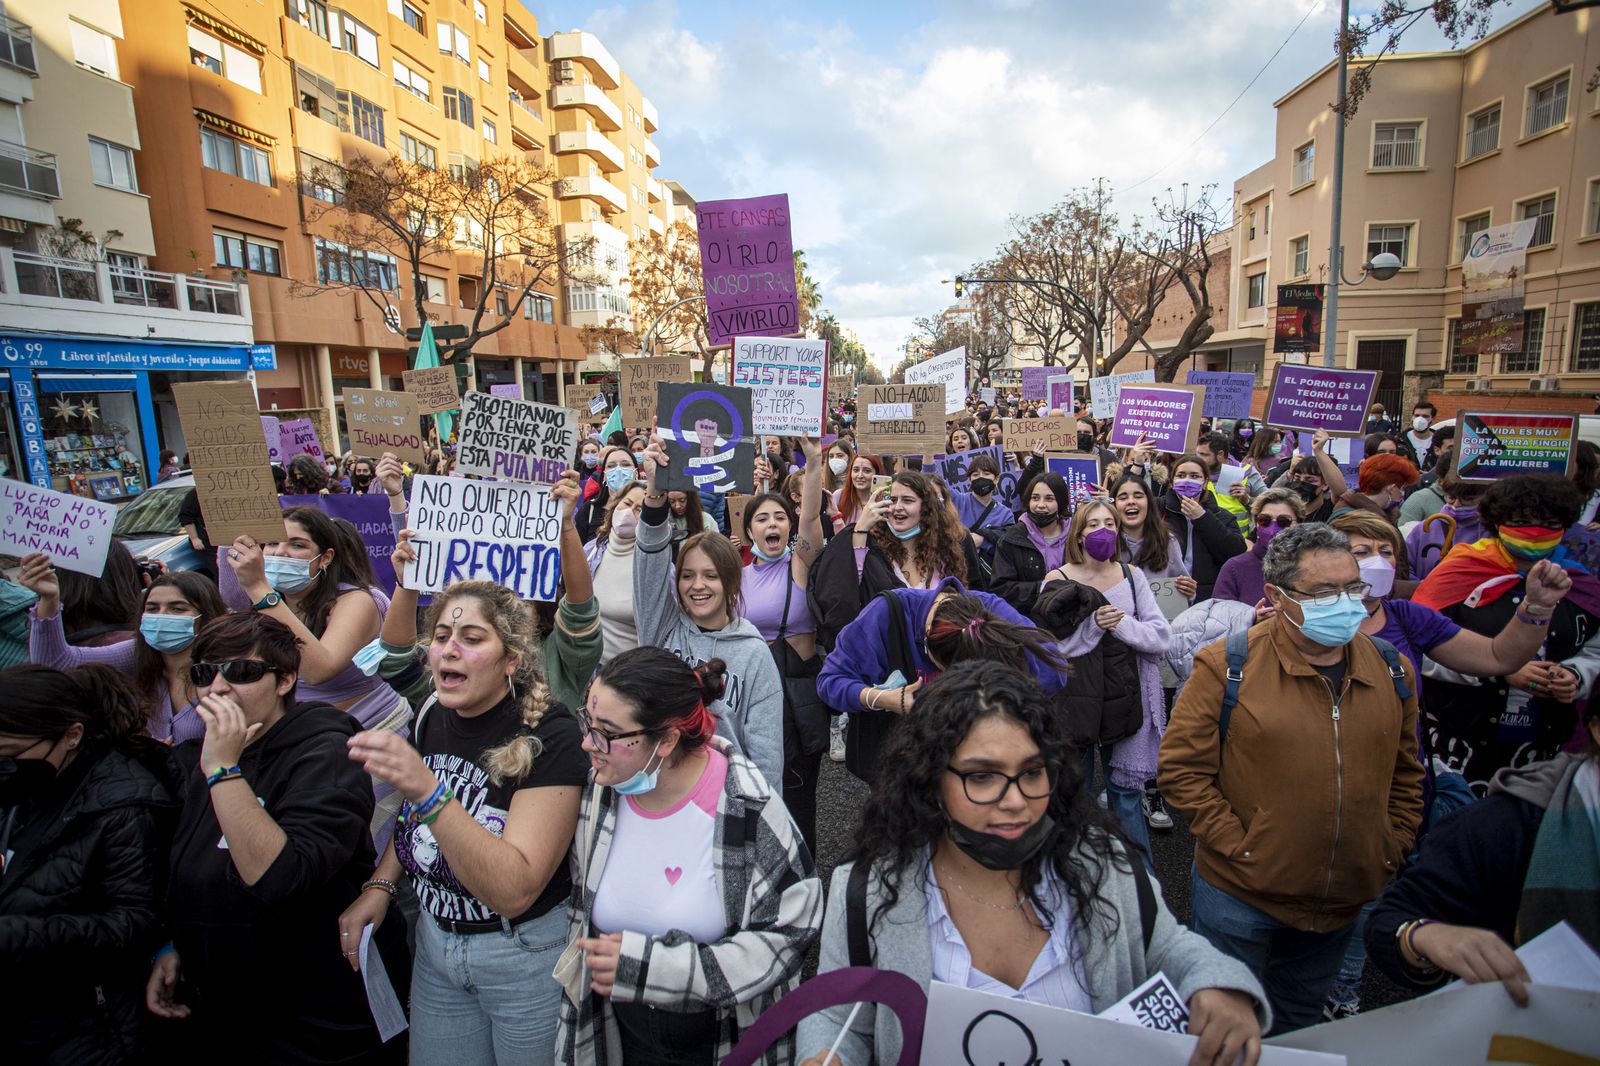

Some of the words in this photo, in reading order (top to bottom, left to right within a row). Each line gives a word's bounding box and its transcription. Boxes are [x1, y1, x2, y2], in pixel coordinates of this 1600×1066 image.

[731, 207, 788, 228] CANSAS
[61, 350, 95, 362] Libros
[96, 351, 140, 365] infantiles
[740, 343, 791, 361] SUPPORT
[795, 346, 824, 364] YOUR
[339, 355, 369, 373] rtve
[628, 364, 643, 381] YO
[734, 361, 822, 388] SISTERS
[1284, 376, 1297, 385] EL
[1299, 378, 1336, 389] PORNO
[1338, 382, 1351, 390] ES
[1354, 382, 1366, 391] LA
[752, 388, 768, 399] NOT
[774, 389, 796, 399] YOUR
[1296, 388, 1334, 400] TEORÍA
[1336, 393, 1349, 401] LA
[197, 400, 225, 420] NO
[469, 392, 501, 416] SIGO
[868, 404, 913, 419] SEXUAL
[1122, 398, 1135, 406] LOS
[1136, 399, 1187, 410] VIOLADORES
[1277, 397, 1333, 411] VIOLACIÓN
[1335, 403, 1348, 411] ES
[1350, 403, 1363, 412] LA
[1127, 408, 1173, 419] EXISTIERON
[1292, 408, 1343, 422] PRÁCTICA
[464, 411, 495, 432] POR
[497, 416, 541, 439] TENER
[541, 426, 573, 447] QUE
[868, 420, 927, 434] TRABAJO
[1010, 420, 1062, 435] DERECHOS
[1120, 418, 1142, 427] ANTES
[1144, 420, 1161, 429] QUE
[1162, 422, 1180, 431] LAS
[1475, 427, 1488, 435] LA
[1492, 427, 1516, 436] VIDA
[1519, 427, 1532, 436] ES
[1535, 428, 1559, 437] MUY
[193, 423, 246, 446] SOMOS
[294, 433, 315, 445] ARTE
[352, 428, 420, 450] IGUALDAD
[1005, 437, 1020, 450] PA
[1049, 432, 1078, 448] PUTAS
[1463, 437, 1499, 446] CORTA
[1501, 438, 1529, 447] PARA
[1532, 439, 1569, 448] FINGIR
[461, 428, 537, 456] PROTESTAR
[542, 445, 568, 461] POR
[1463, 448, 1485, 456] QUE
[1487, 447, 1503, 456] NO
[1506, 449, 1519, 457] TE
[1522, 449, 1566, 459] GUSTAN
[459, 446, 491, 468] ESTA
[492, 450, 530, 481] PUTA
[1477, 458, 1496, 467] LAS
[1499, 459, 1549, 469] MUJERES
[207, 467, 260, 493] SOMOS
[4, 485, 61, 509] LUCHO
[71, 501, 108, 525] HOY,
[420, 480, 452, 508] NO
[462, 483, 531, 518] QUIERO
[13, 502, 50, 522] PARA
[26, 520, 70, 539] MORIR
[416, 507, 483, 536] PIROPO
[492, 514, 560, 542] QUIERO
[2, 529, 79, 560] MAÑANA
[410, 539, 441, 588] TU
[442, 538, 562, 600] RESPETO
[1154, 985, 1183, 1021] LOS
